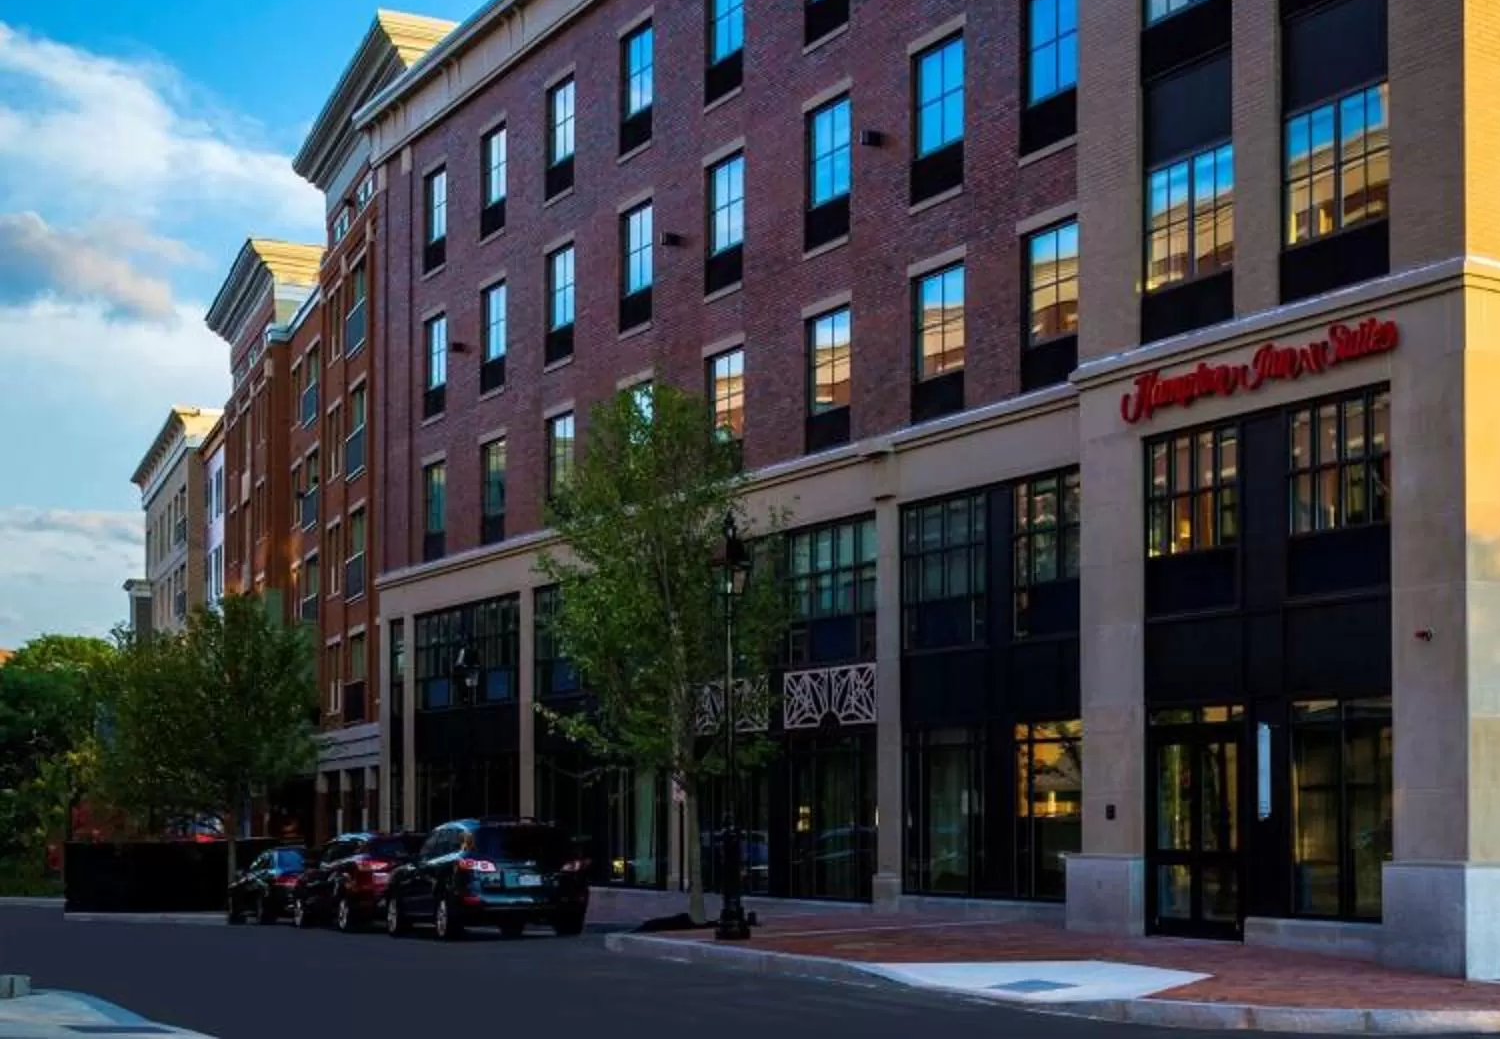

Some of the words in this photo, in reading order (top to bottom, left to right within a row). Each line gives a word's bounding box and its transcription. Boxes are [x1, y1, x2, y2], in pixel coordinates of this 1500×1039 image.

[1120, 363, 1249, 424] Hampton
[1249, 343, 1308, 390] Inn
[1328, 317, 1398, 367] Suites
